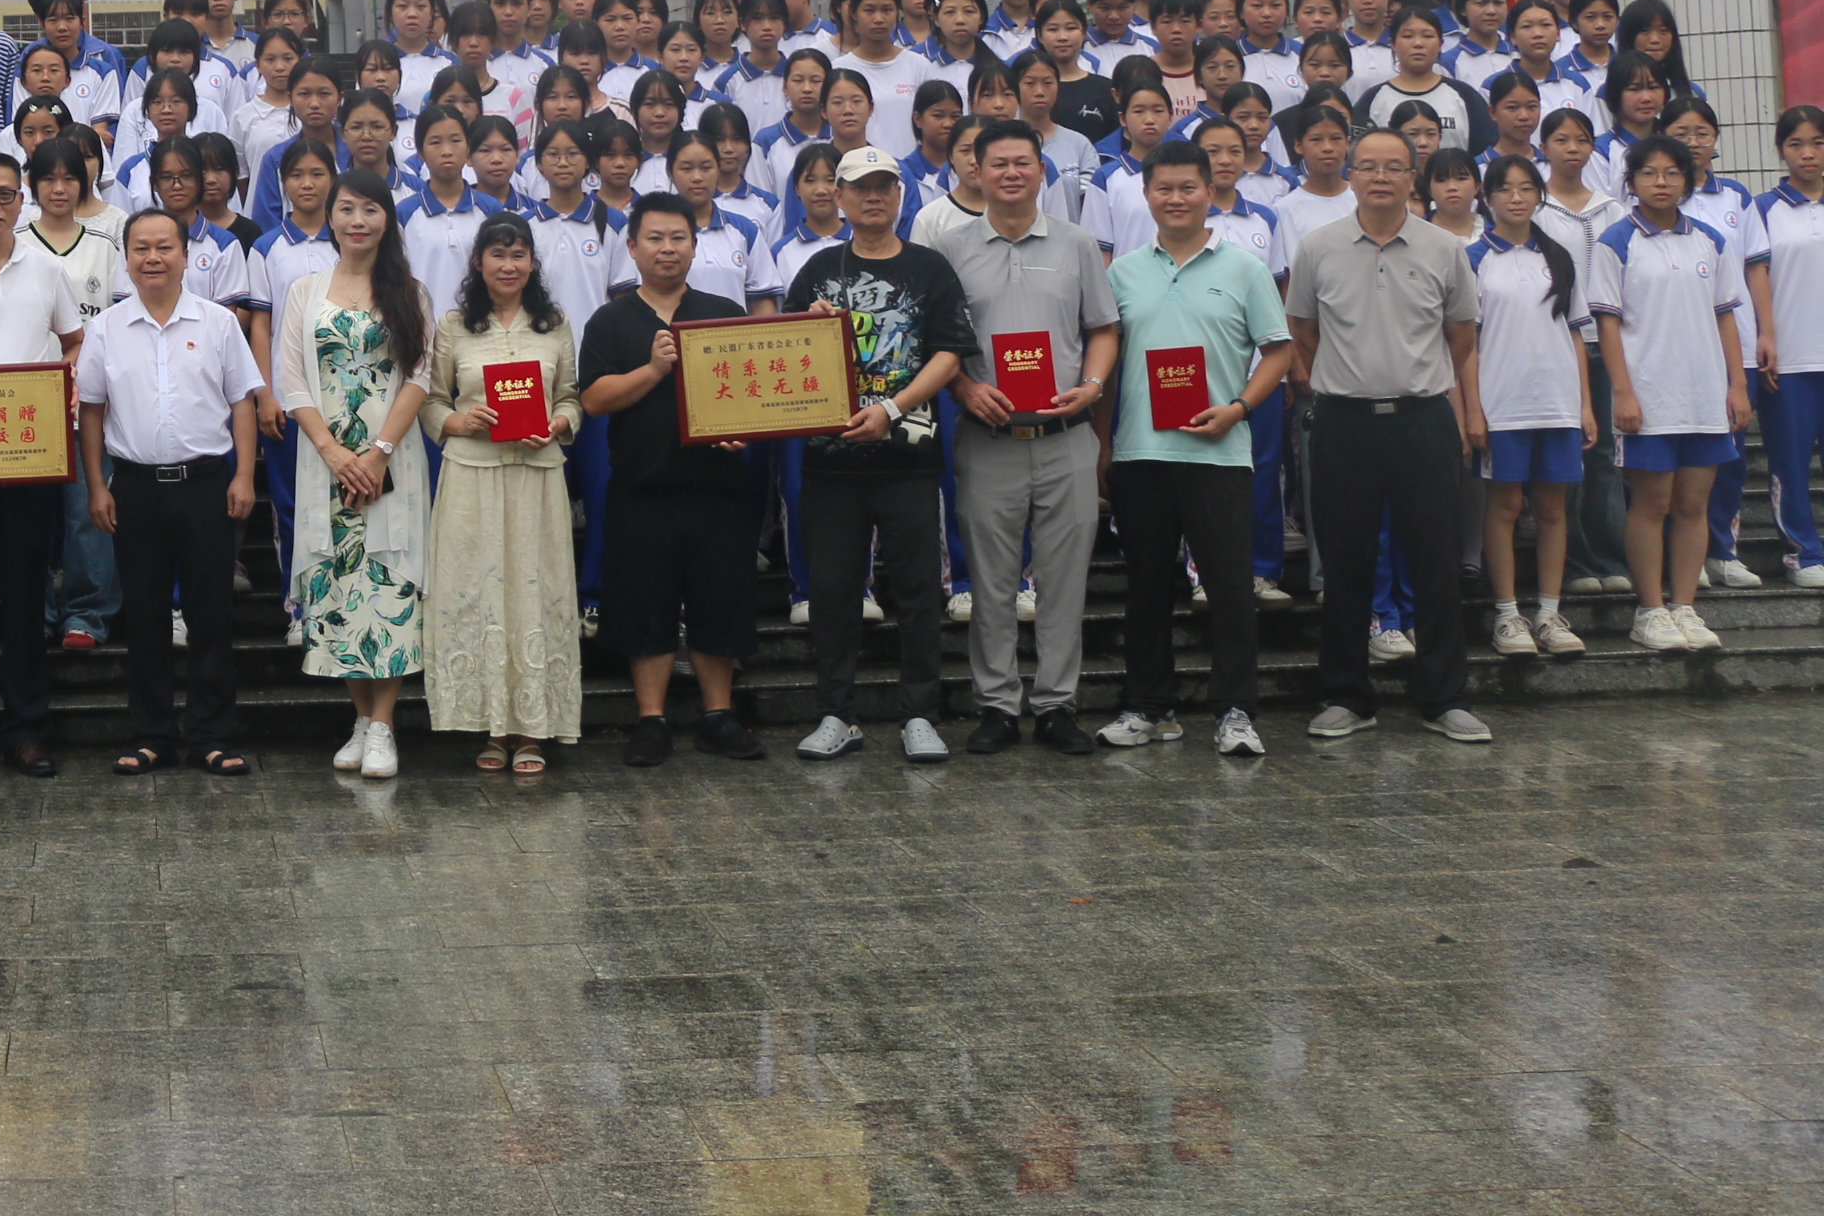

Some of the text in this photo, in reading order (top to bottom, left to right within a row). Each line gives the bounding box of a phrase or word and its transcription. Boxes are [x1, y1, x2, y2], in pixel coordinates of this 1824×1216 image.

[712, 353, 812, 380] 情系瑶乡
[715, 375, 820, 400] 大爱无疆
